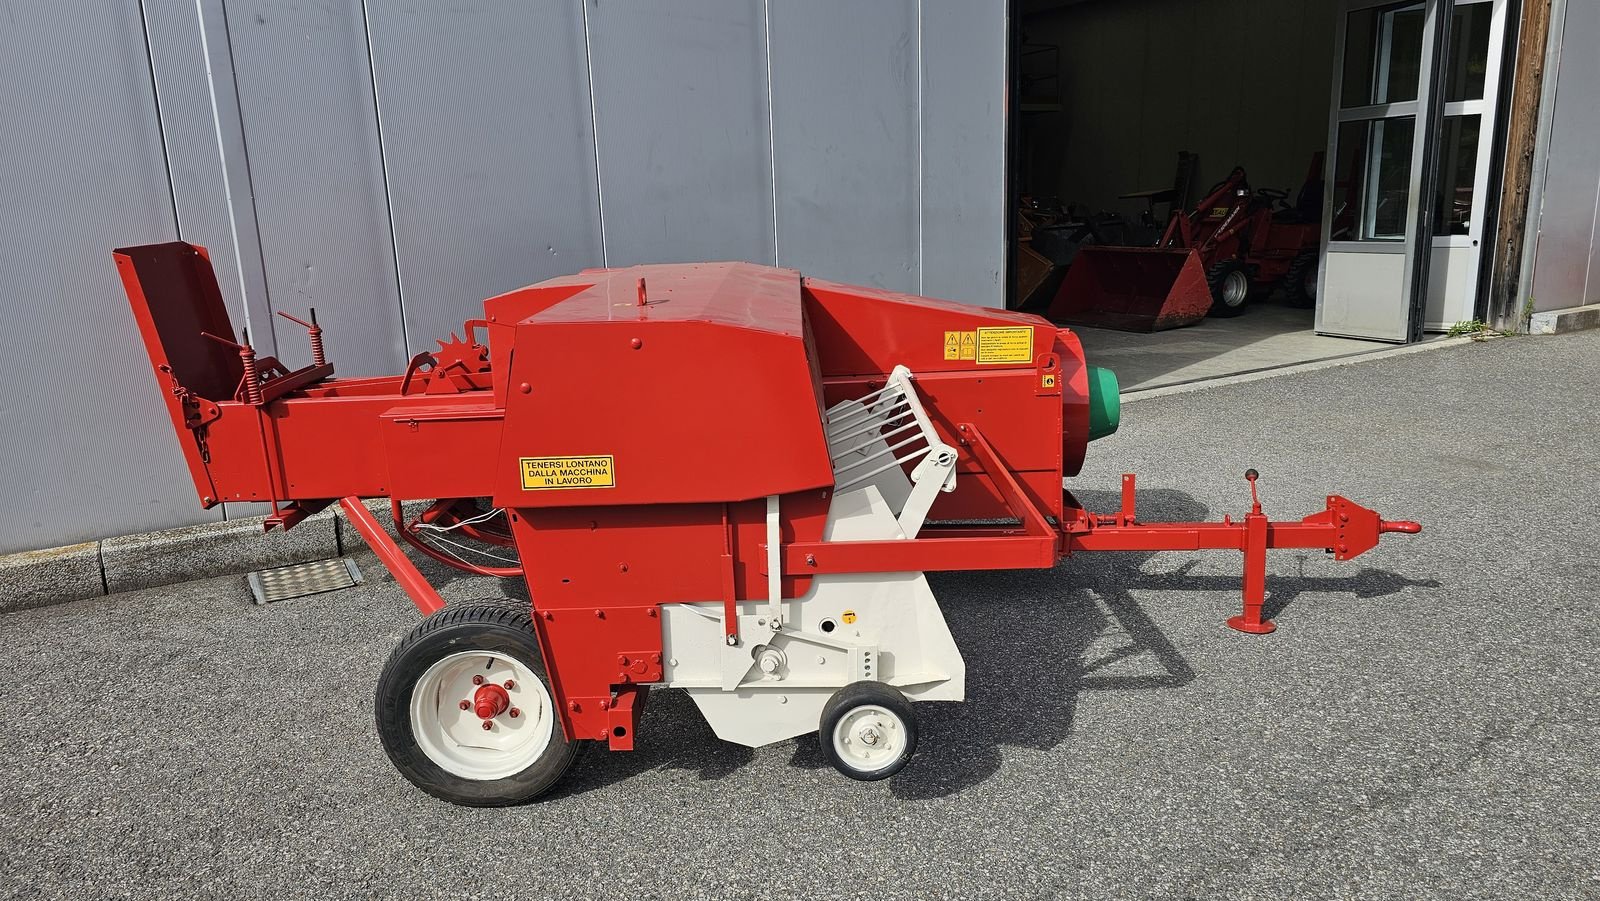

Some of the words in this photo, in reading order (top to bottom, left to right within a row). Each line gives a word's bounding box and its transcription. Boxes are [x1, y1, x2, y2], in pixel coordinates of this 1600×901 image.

[526, 461, 564, 469] TENERSI
[566, 460, 607, 468] LONTANO
[560, 468, 608, 476] MACCHINA
[556, 477, 592, 485] LAVORO
